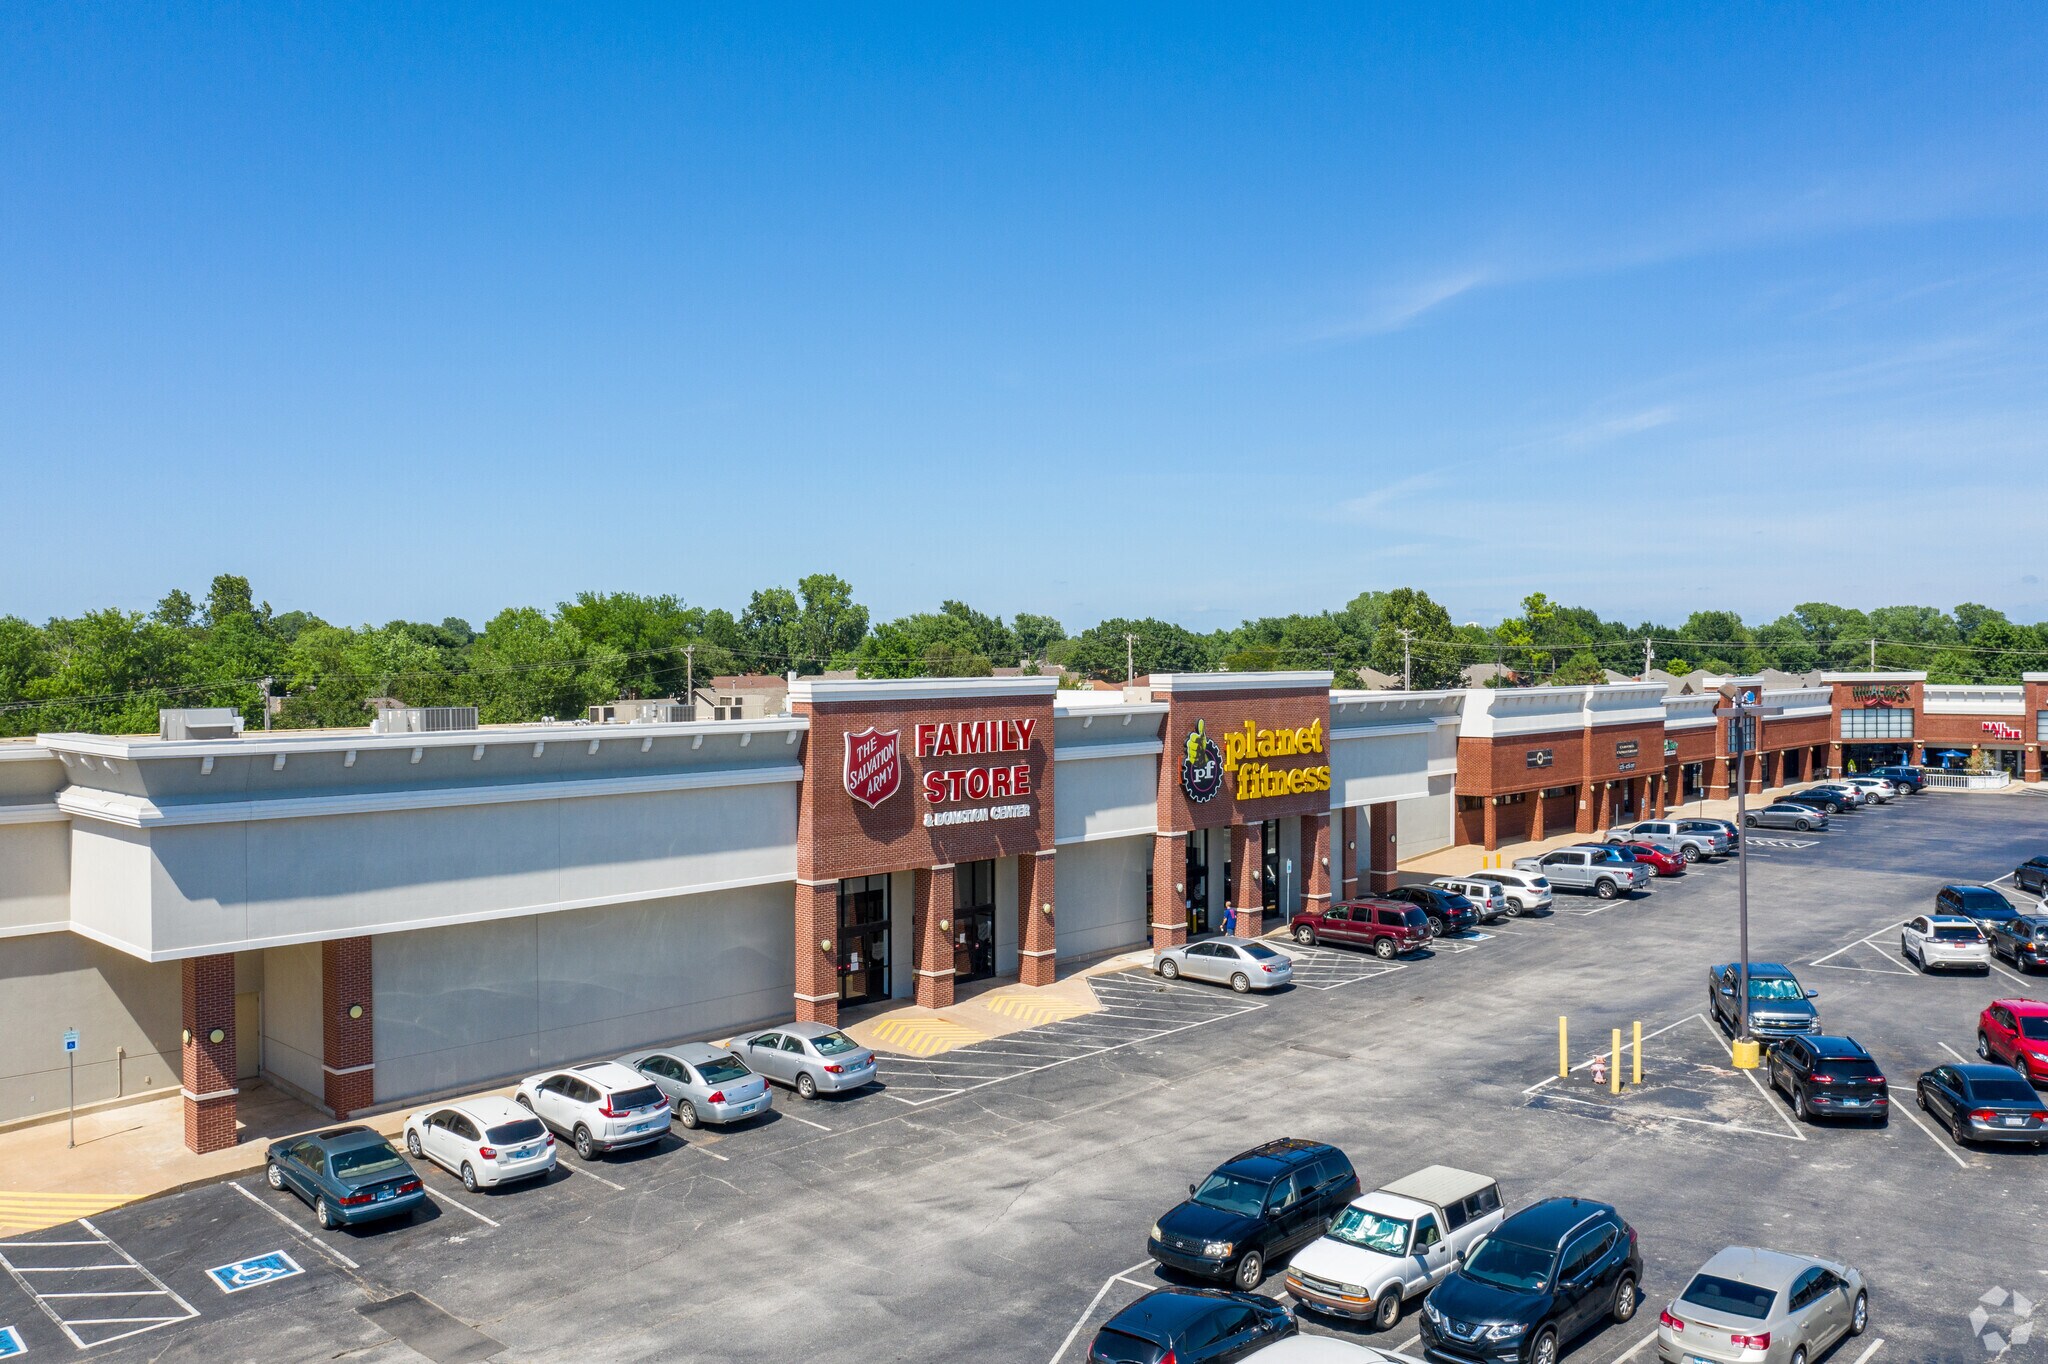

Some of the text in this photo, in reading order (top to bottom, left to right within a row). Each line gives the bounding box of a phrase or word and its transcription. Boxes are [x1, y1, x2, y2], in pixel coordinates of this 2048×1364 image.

[915, 719, 1037, 757] FAMILY
[1982, 721, 2008, 731] NAIL
[1993, 729, 2021, 739] TIME
[856, 736, 877, 763] THE
[1224, 717, 1323, 772] planet
[850, 739, 894, 790] SALVATION
[866, 762, 894, 798] ARMY
[1193, 760, 1216, 783] pf
[1236, 762, 1331, 801] fitness
[923, 764, 1031, 804] STORE
[923, 804, 1031, 828] & DONATION CENTER
